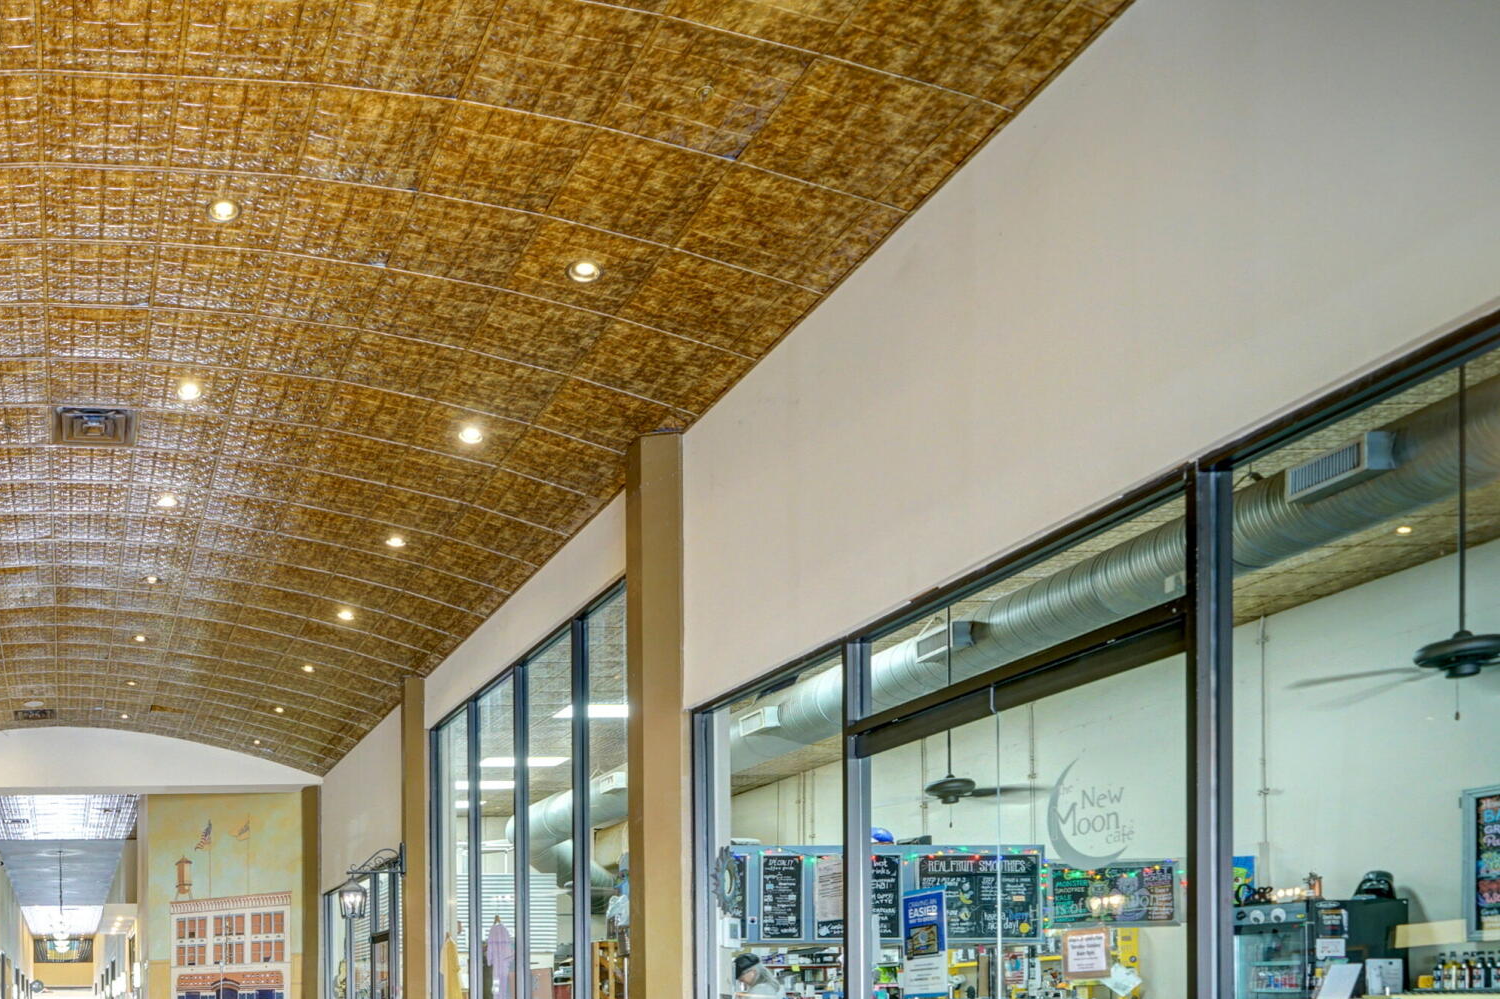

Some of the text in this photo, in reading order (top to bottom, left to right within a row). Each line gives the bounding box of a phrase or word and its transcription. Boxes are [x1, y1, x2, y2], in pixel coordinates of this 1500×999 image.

[1080, 786, 1124, 809] New
[1052, 801, 1120, 837] Moon
[908, 905, 938, 918] EASIER
